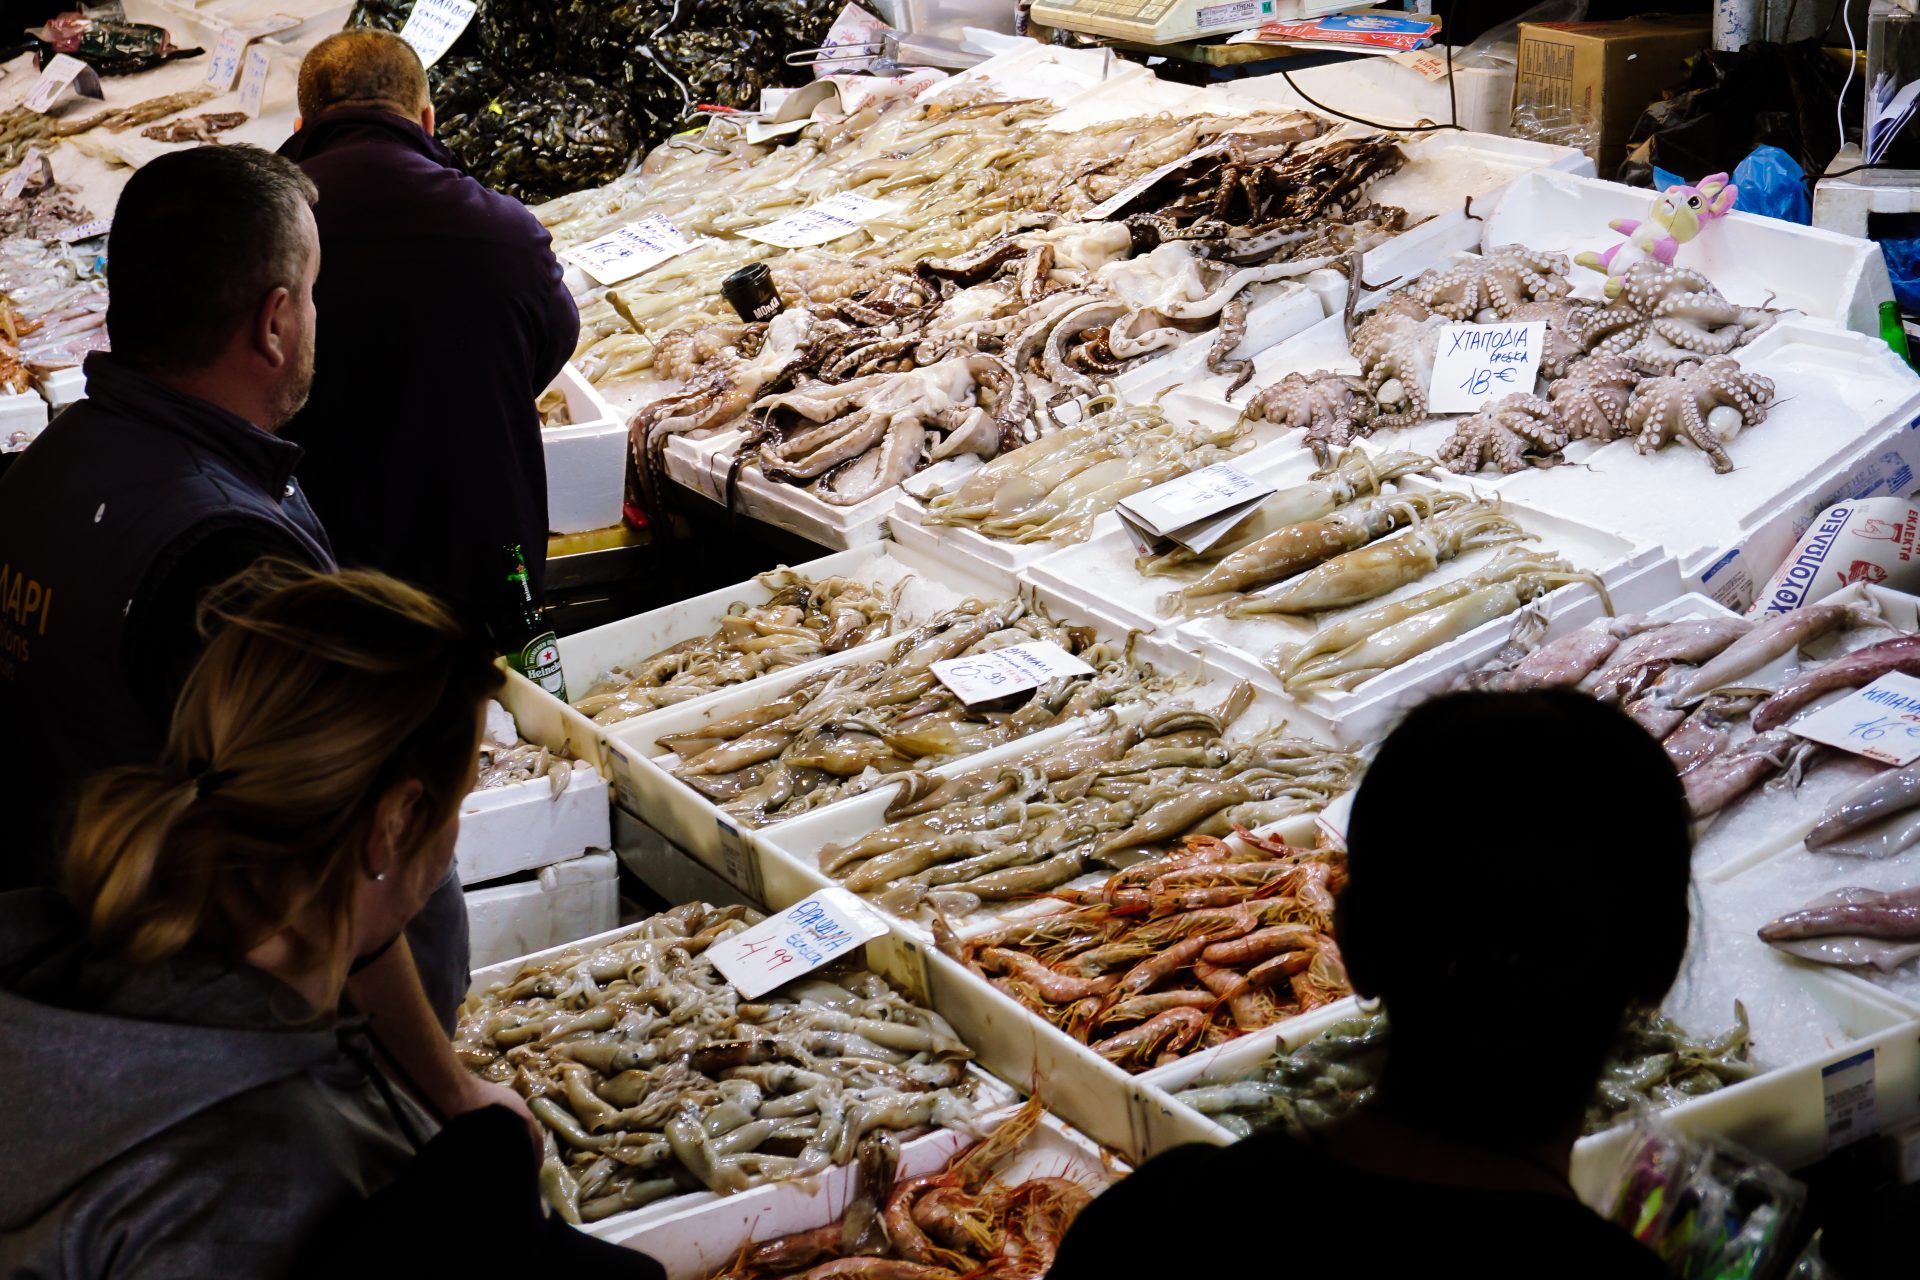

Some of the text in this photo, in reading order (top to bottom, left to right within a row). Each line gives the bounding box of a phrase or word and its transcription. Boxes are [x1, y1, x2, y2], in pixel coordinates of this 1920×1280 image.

[1232, 3, 1255, 12] ATHENA
[1448, 327, 1529, 357] ΧΤΑΠΟΔΙΑ
[1899, 509, 1919, 561] ΕΚΛΕΚΤΑ
[1764, 508, 1849, 616] ΧΘΥΟΠΩΛΕΙΟ
